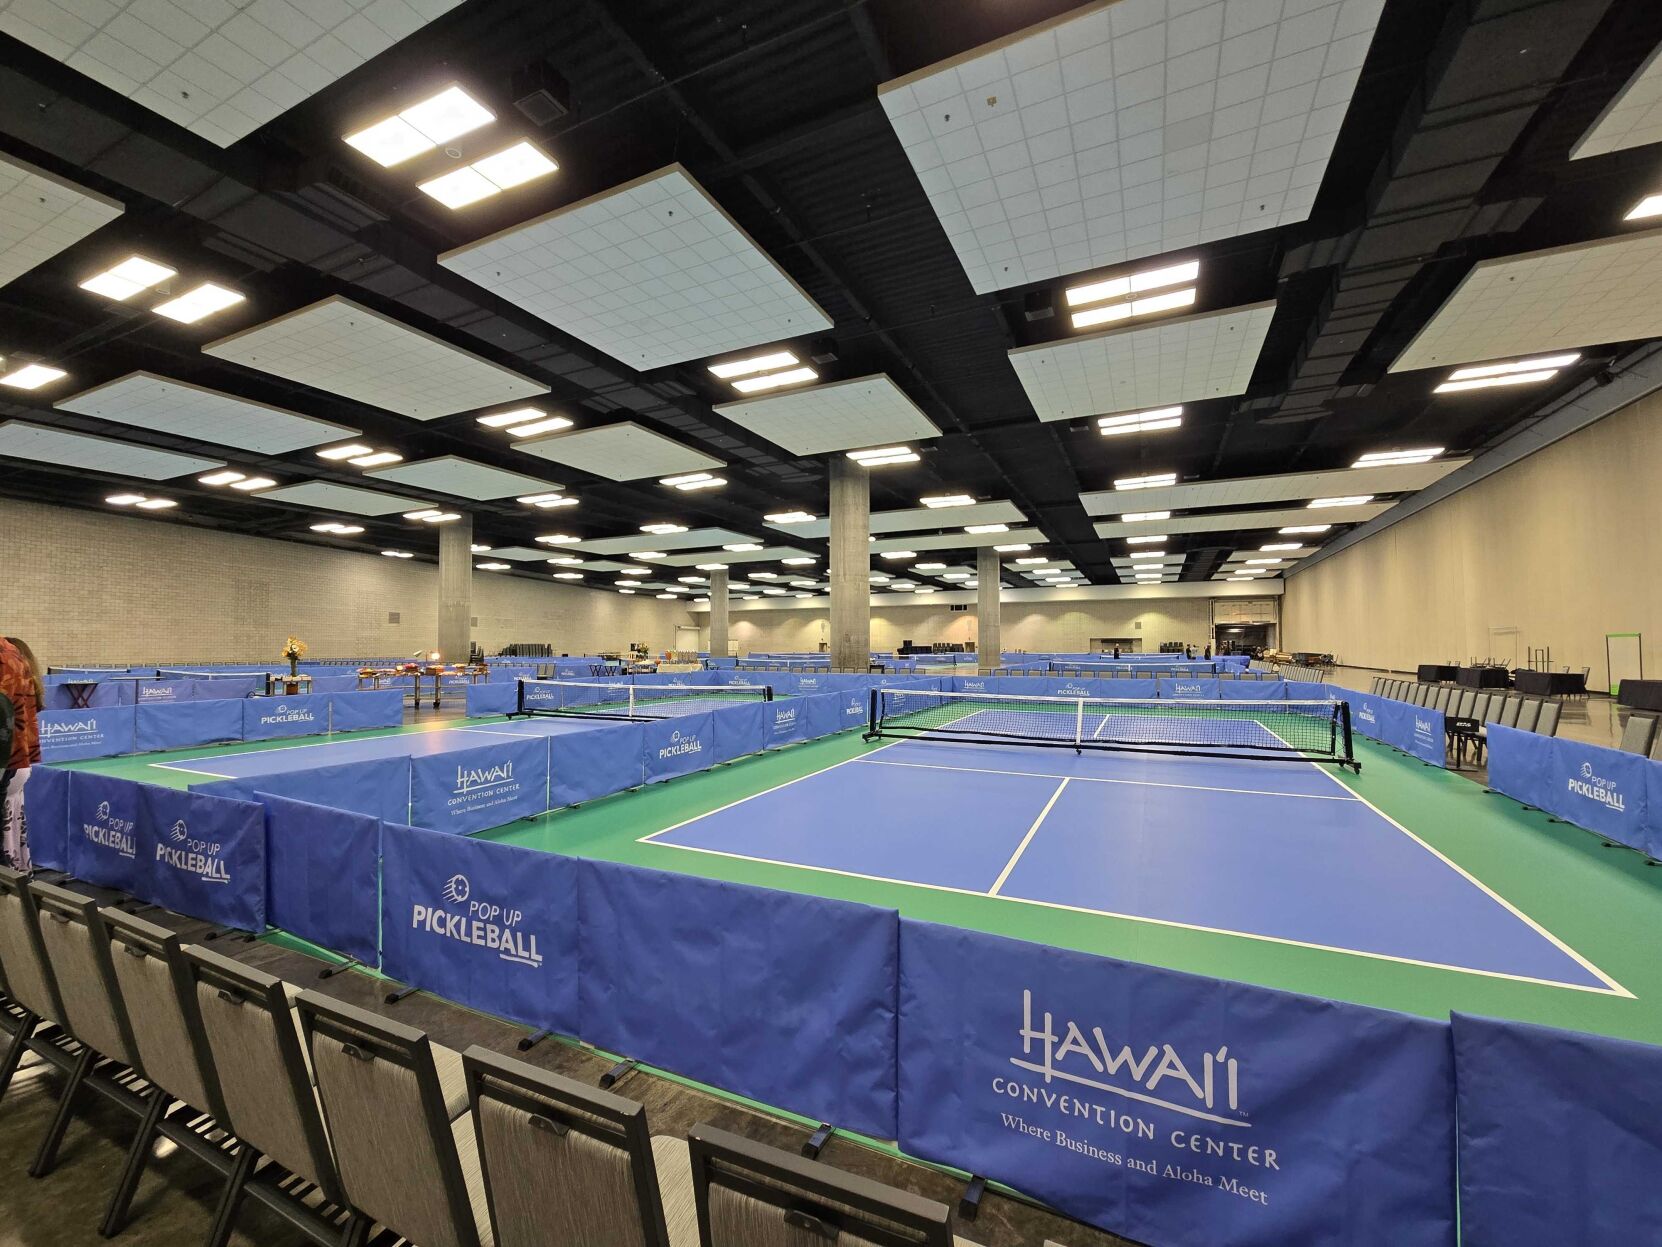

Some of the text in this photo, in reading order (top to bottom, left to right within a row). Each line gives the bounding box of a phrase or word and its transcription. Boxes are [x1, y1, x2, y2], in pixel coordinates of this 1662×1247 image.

[261, 713, 315, 725] PICKLEBALL
[659, 740, 702, 759] PICKLEBALL
[447, 783, 520, 806] CONVENTION CENTER
[1568, 778, 1626, 809] PICKLEBALL
[1591, 776, 1617, 791] POP UP
[109, 817, 134, 833] POP UP
[155, 842, 231, 879] PICKLEBALL
[187, 839, 221, 856] POP UP
[469, 900, 522, 927] POP UP
[412, 904, 543, 962] PICKLEBALL
[1019, 989, 1238, 1110] HAWAI'I
[992, 1077, 1280, 1171] CONVENTION CENTER
[1000, 1112, 1269, 1207] Where Business and Aloha Meet
